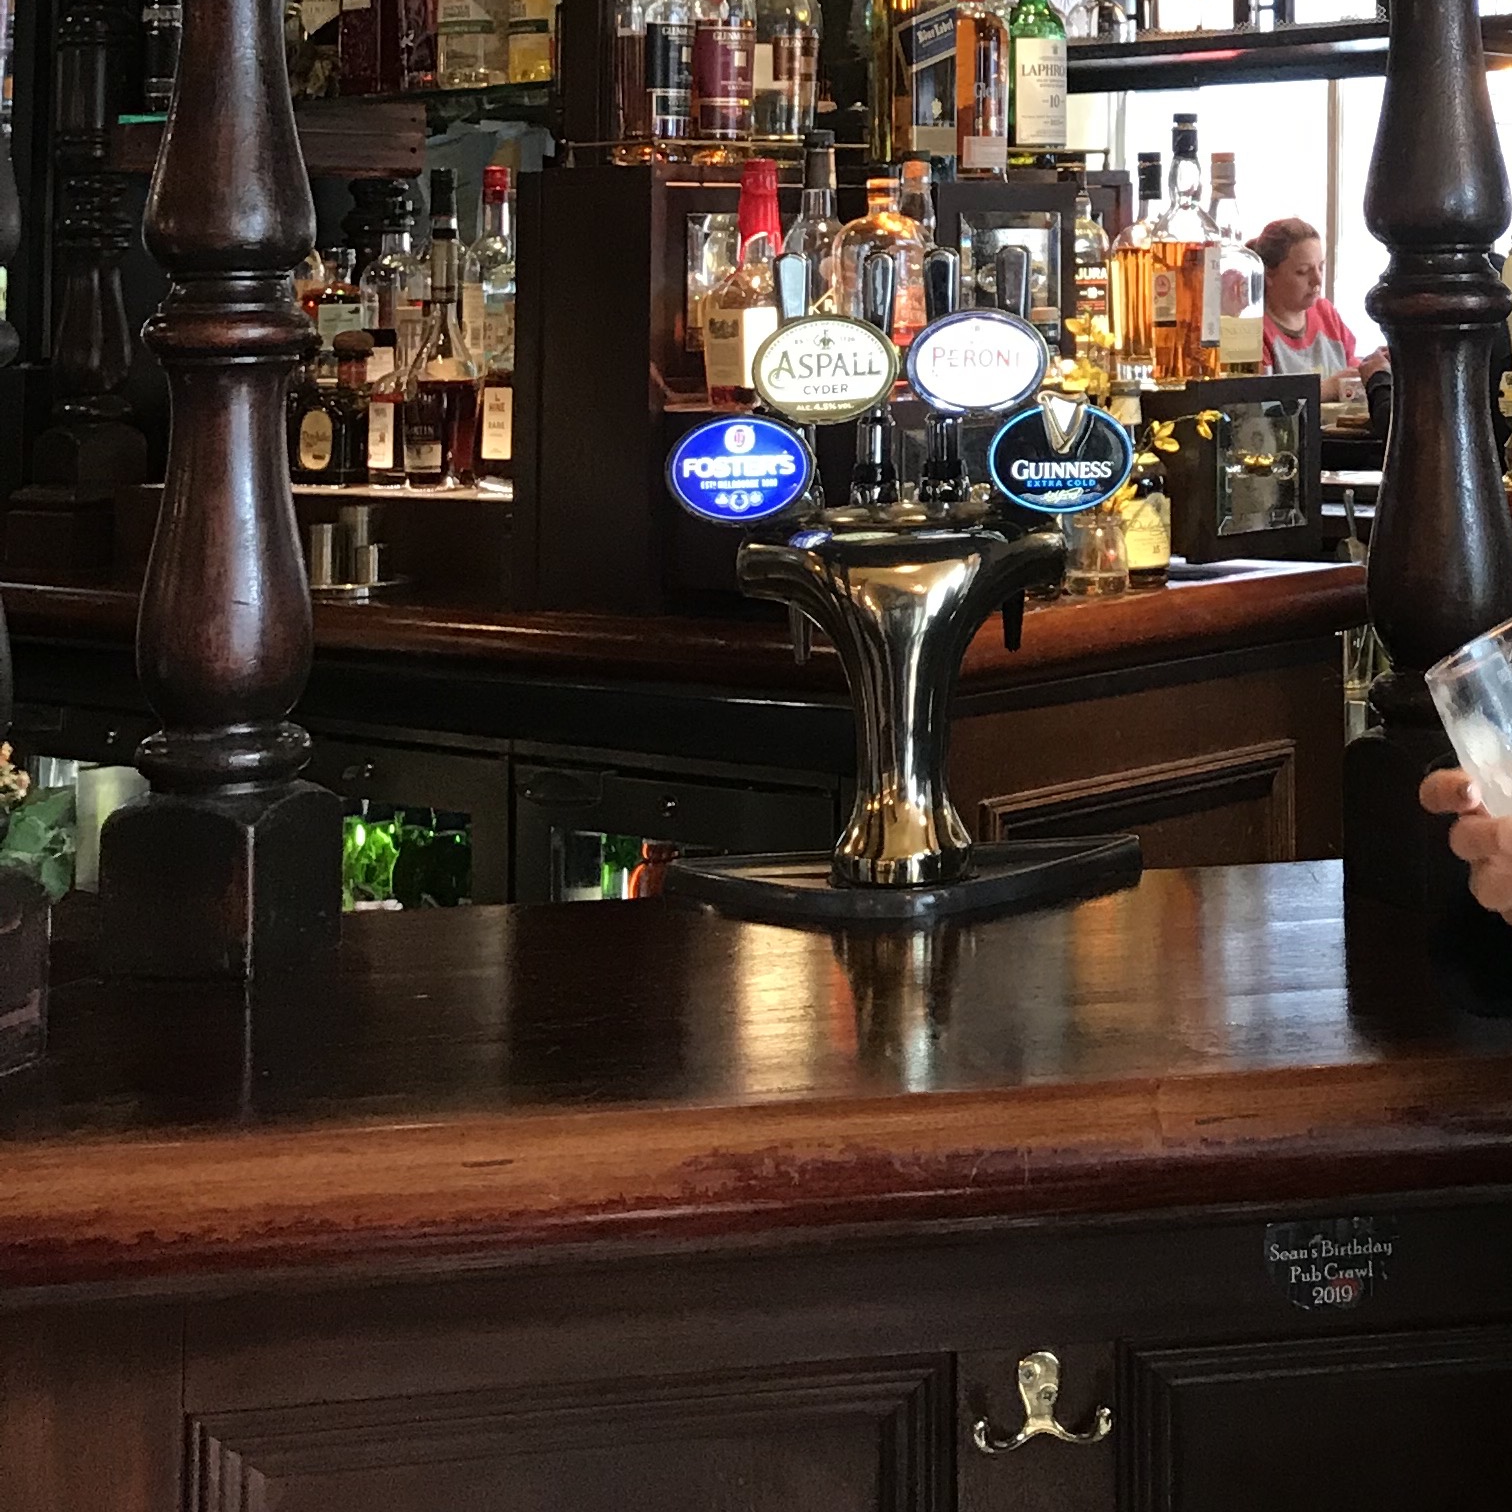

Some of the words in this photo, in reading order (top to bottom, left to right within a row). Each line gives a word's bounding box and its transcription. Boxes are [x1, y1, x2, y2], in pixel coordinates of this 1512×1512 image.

[1074, 267, 1108, 280] JURA
[932, 346, 1020, 367] PERONI
[768, 350, 882, 389] ASPALL
[803, 384, 849, 395] CYDER
[683, 449, 796, 478] FOSTER'S
[1011, 459, 1113, 481] GUINNESS
[1026, 479, 1063, 487] EXTRA
[1066, 478, 1096, 487] COLD
[1321, 1238, 1393, 1258] Birthday
[1290, 1265, 1322, 1283] Pub
[1324, 1261, 1373, 1280] Crawl
[1312, 1285, 1354, 1304] 2019
